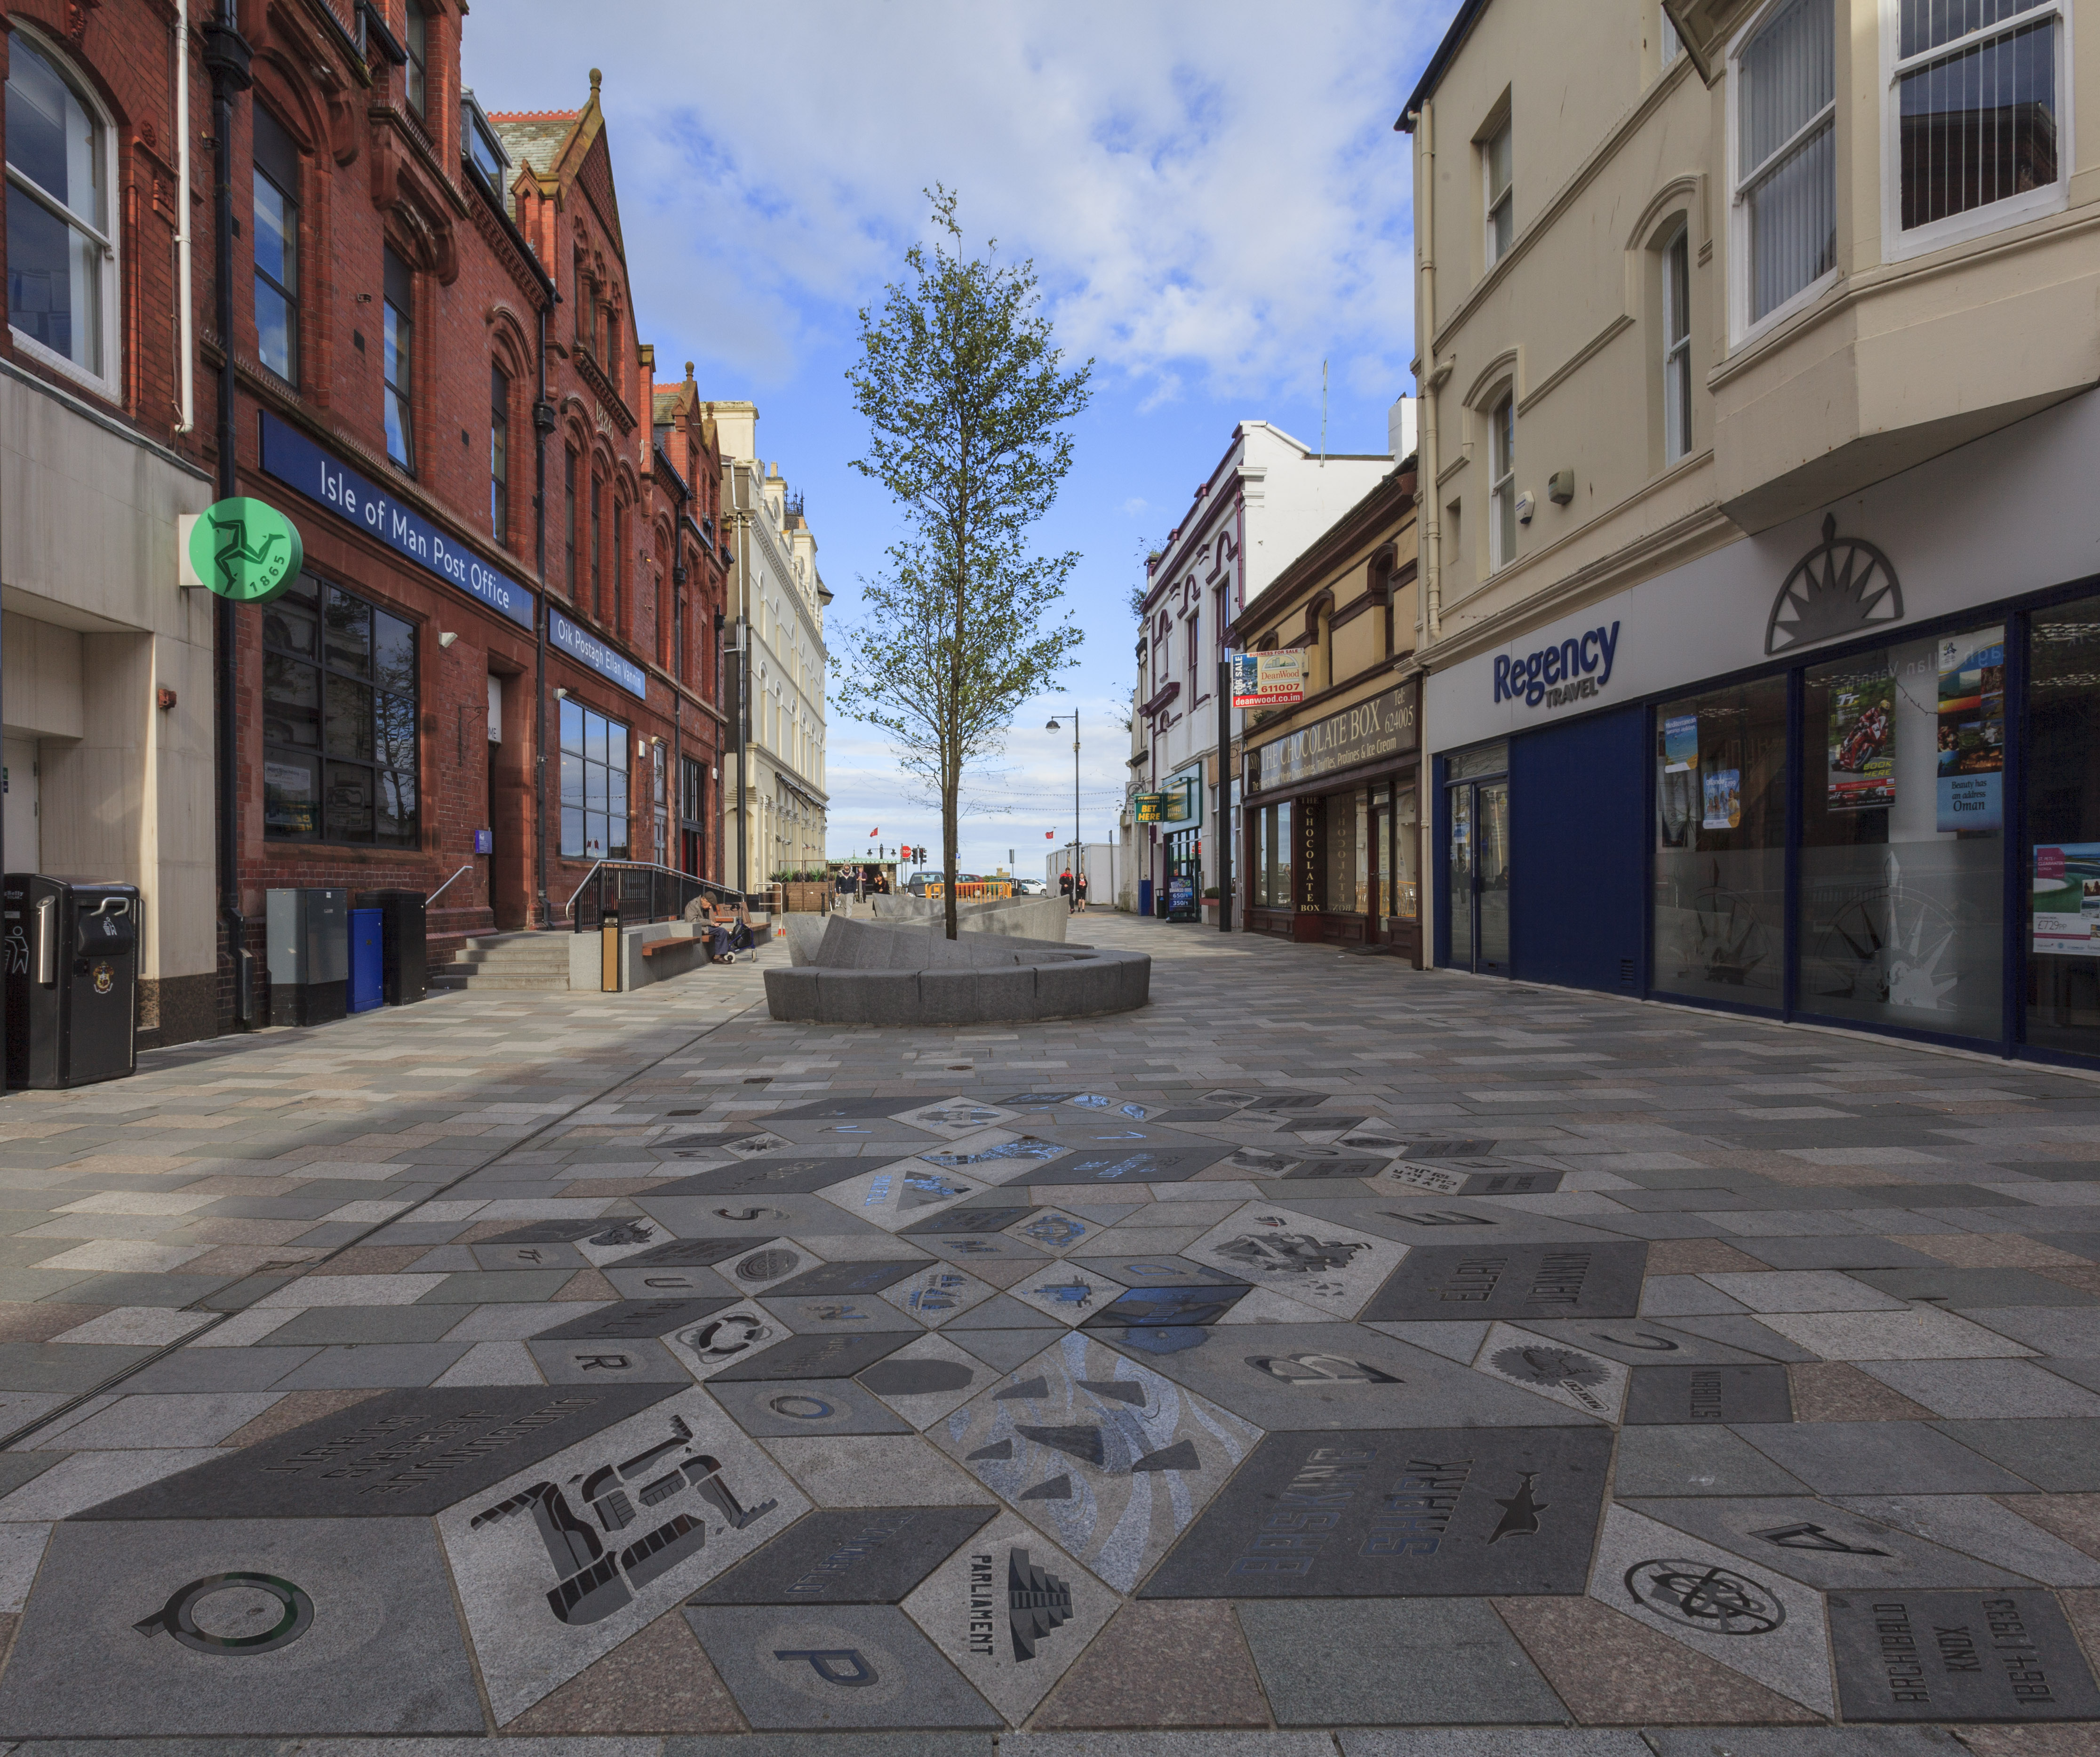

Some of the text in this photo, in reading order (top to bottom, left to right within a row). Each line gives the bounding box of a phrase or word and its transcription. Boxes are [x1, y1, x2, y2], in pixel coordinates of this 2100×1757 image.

[596, 400, 614, 441] 1886
[321, 460, 510, 610] Isle of Man Post Office
[558, 618, 641, 690] Oik Postagh Ellan Vannin
[1493, 621, 1620, 706] Regency
[1261, 669, 1300, 680] DeanWood
[1261, 683, 1300, 693] 611007
[1545, 675, 1598, 708] TRAVEL
[1836, 686, 1853, 695] 2015
[1235, 693, 1300, 706] deanwood.co.im
[1393, 688, 1405, 706] Tel:
[1837, 693, 1860, 706] TT
[1261, 743, 1278, 772] THE
[1280, 714, 1347, 765] CHOCOLATE
[1350, 699, 1381, 741] BOX
[1385, 705, 1413, 733] 624005
[1666, 717, 1696, 728] Mediterranean
[1338, 749, 1360, 765] Pralines
[1361, 747, 1366, 757] &
[1366, 744, 1375, 756] Ice
[1376, 737, 1396, 753] Cream
[1863, 760, 1893, 770] BOOK
[1863, 769, 1893, 778] HERE
[1951, 781, 1973, 789] Beauty
[1141, 805, 1157, 813] BET
[1953, 800, 1985, 811] Oman
[1962, 791, 1986, 799] address
[1138, 813, 1161, 821] HERE
[1306, 807, 1314, 902] CHOCOLATE
[864, 1175, 893, 1206] SNAEFELL
[1434, 1258, 1508, 1302] ELLAN
[1522, 1253, 1592, 1305] VANNIN
[1562, 1380, 1605, 1409] MANX CAT
[1689, 1371, 1722, 1418] STUBBIN
[261, 1414, 431, 1475] STABIT
[319, 1409, 501, 1479] JECERIS
[358, 1396, 604, 1495] QUOCUNQUE
[1226, 1447, 1378, 1577] BASKING
[1358, 1459, 1476, 1557] SHARK
[970, 1555, 993, 1656] PARLIAMENT
[1982, 1599, 2028, 1640] 1933
[1872, 1602, 1930, 1703] ARCHIBALD
[1933, 1626, 1982, 1673] KNOX
[2004, 1654, 2056, 1705] 1864
